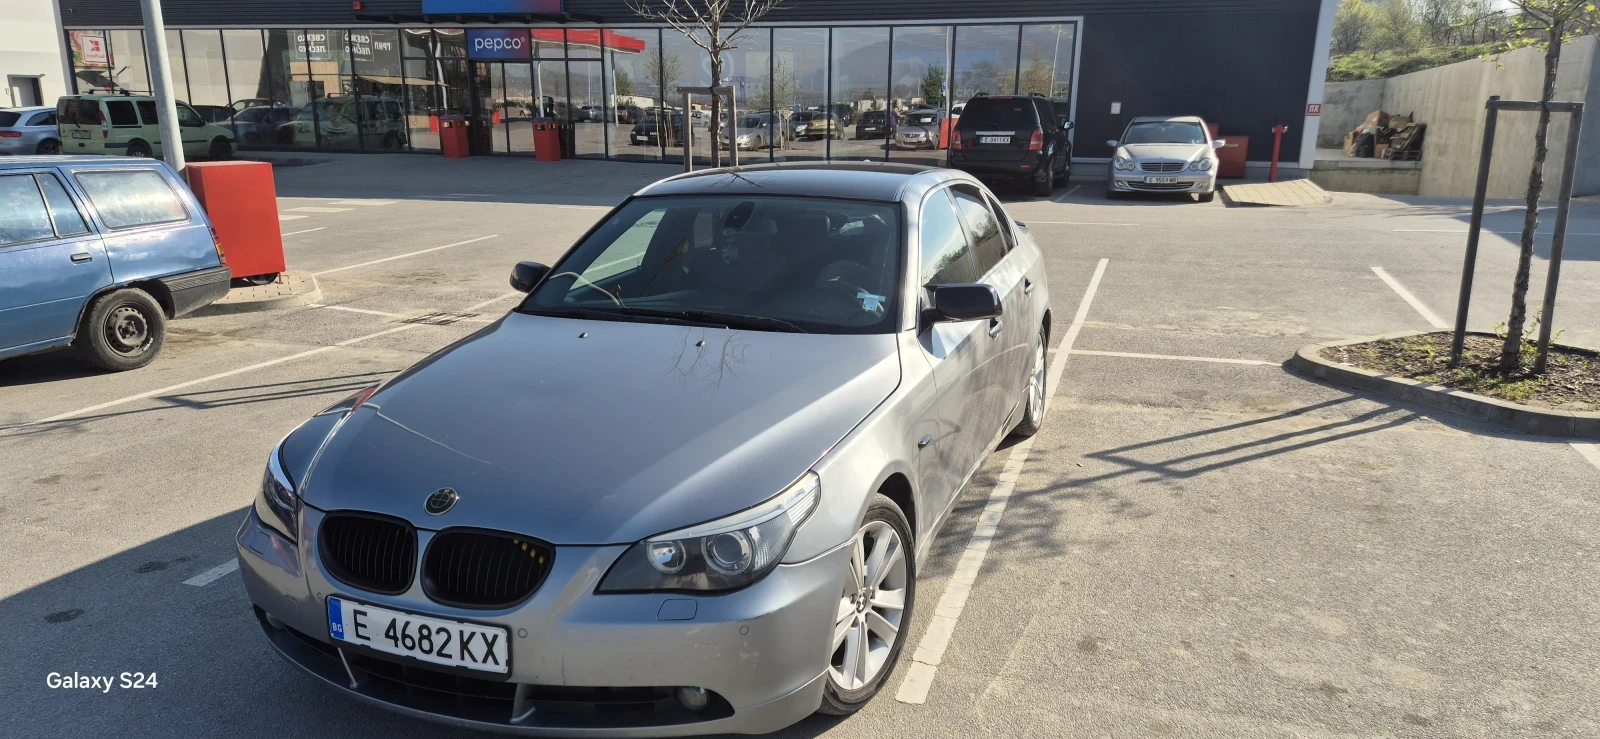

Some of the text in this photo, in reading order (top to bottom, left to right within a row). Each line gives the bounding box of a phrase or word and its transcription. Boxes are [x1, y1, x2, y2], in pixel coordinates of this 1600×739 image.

[474, 37, 522, 52] pepco
[331, 622, 343, 633] BG
[353, 608, 371, 641] E
